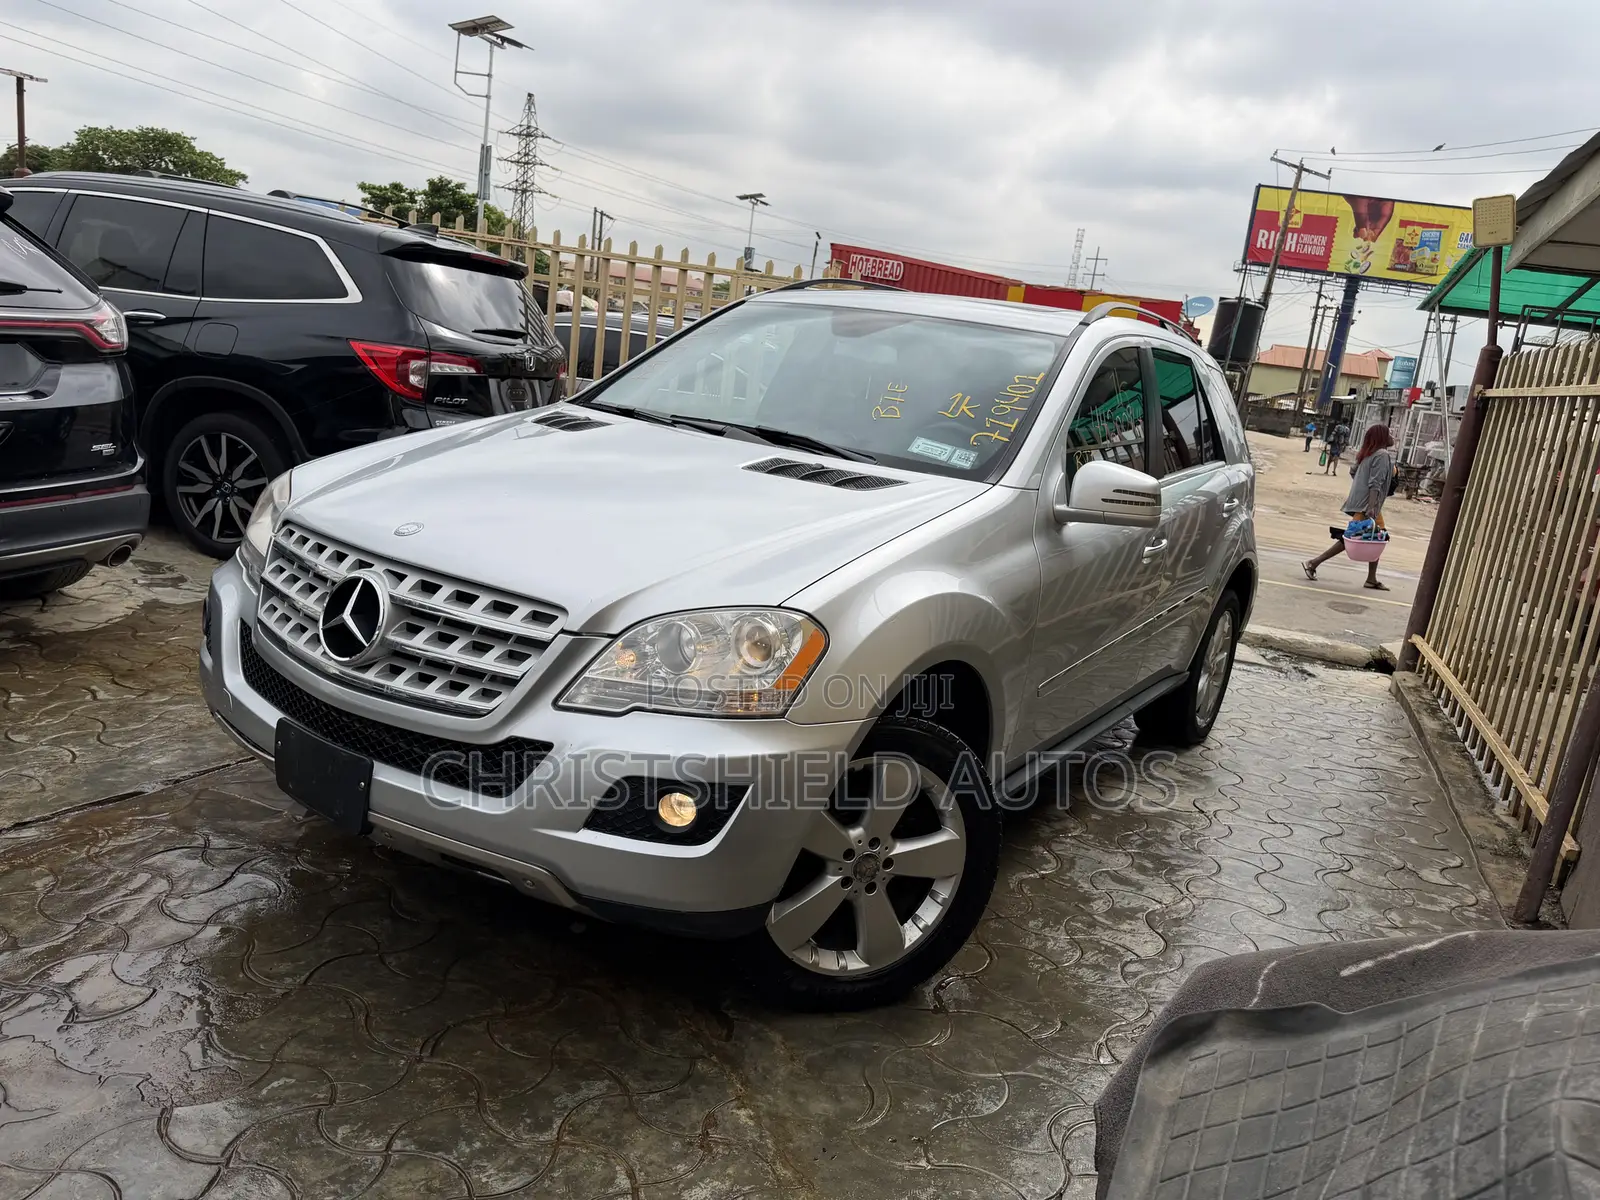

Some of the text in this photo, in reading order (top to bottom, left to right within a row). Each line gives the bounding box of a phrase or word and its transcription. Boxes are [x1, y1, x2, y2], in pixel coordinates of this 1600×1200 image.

[1298, 233, 1328, 246] CHICKEN
[1296, 244, 1326, 256] FLAVOUR
[433, 396, 469, 405] PILOT
